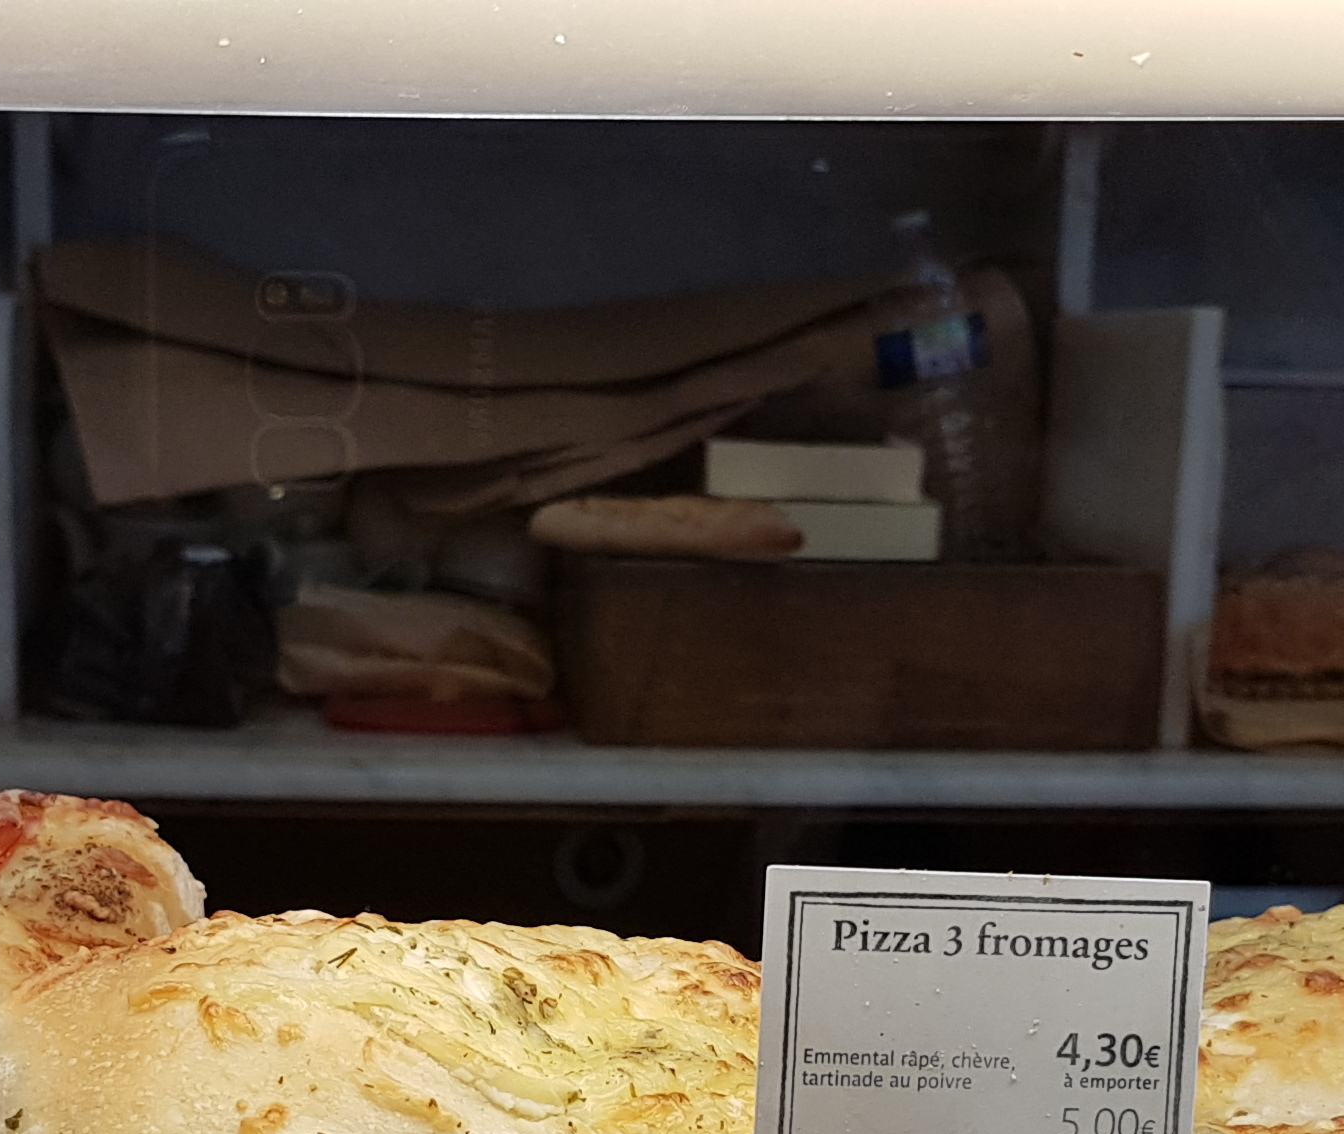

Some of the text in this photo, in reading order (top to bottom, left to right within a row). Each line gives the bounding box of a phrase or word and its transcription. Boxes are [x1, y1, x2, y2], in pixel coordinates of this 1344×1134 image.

[831, 918, 1149, 970] Pizza 3 fromages
[803, 1048, 1016, 1072] Emmental râpé, chèvre,
[1056, 1032, 1161, 1072] 4,30€
[801, 1070, 973, 1092] tartinade au poivre
[1063, 1072, 1160, 1092] à emporter
